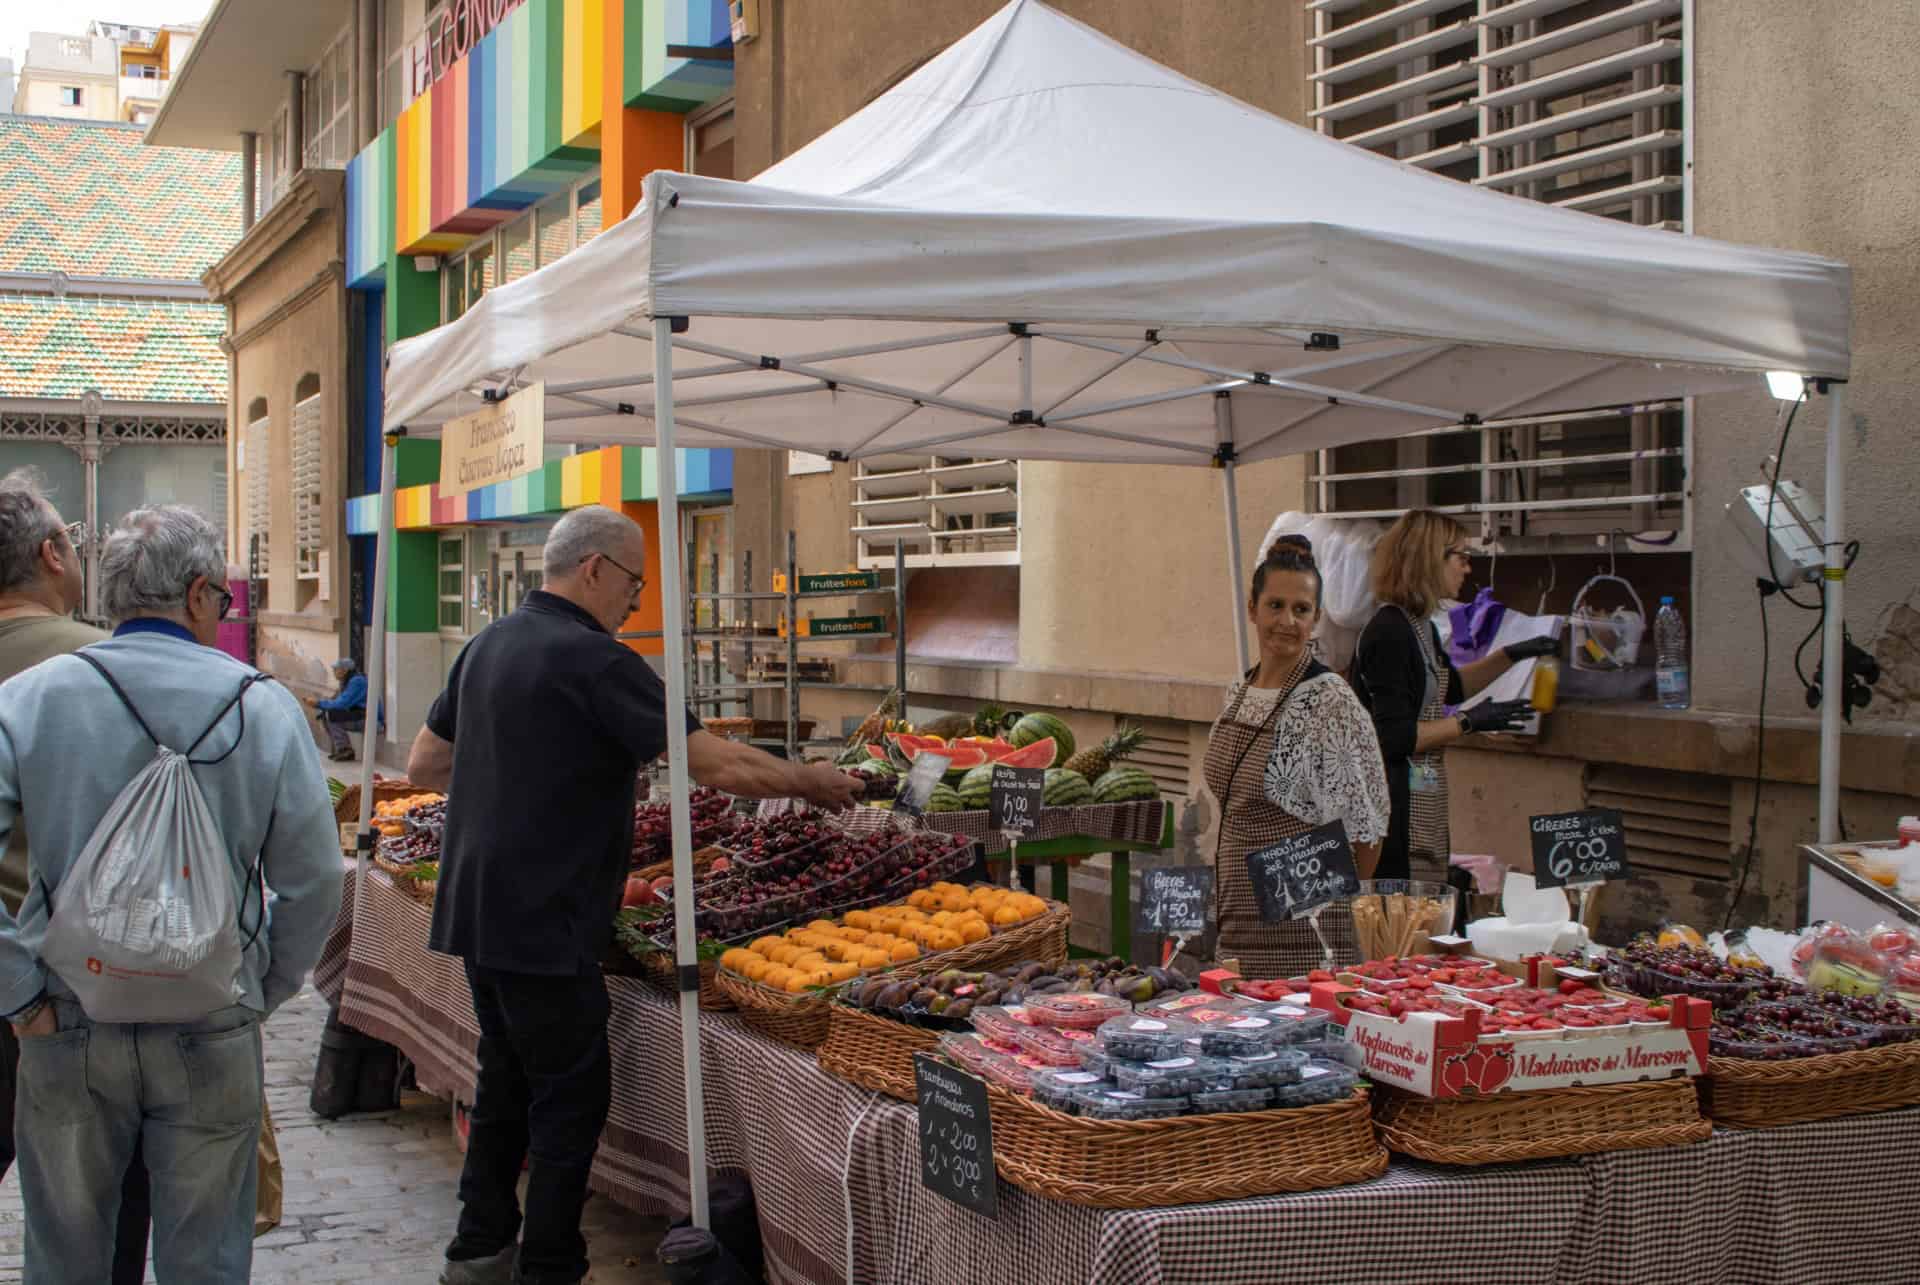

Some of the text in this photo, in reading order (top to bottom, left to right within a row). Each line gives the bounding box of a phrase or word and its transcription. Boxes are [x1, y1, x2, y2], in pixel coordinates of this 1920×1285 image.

[809, 578, 868, 589] fruitesfont
[820, 622, 873, 633] fruitesfont
[1548, 837, 1608, 879] 6'00
[1352, 1025, 1429, 1065] Maduixots del
[1514, 1045, 1693, 1079] Maduixots del Maresme
[1361, 1047, 1416, 1082] Maresme
[928, 1143, 940, 1176] 2
